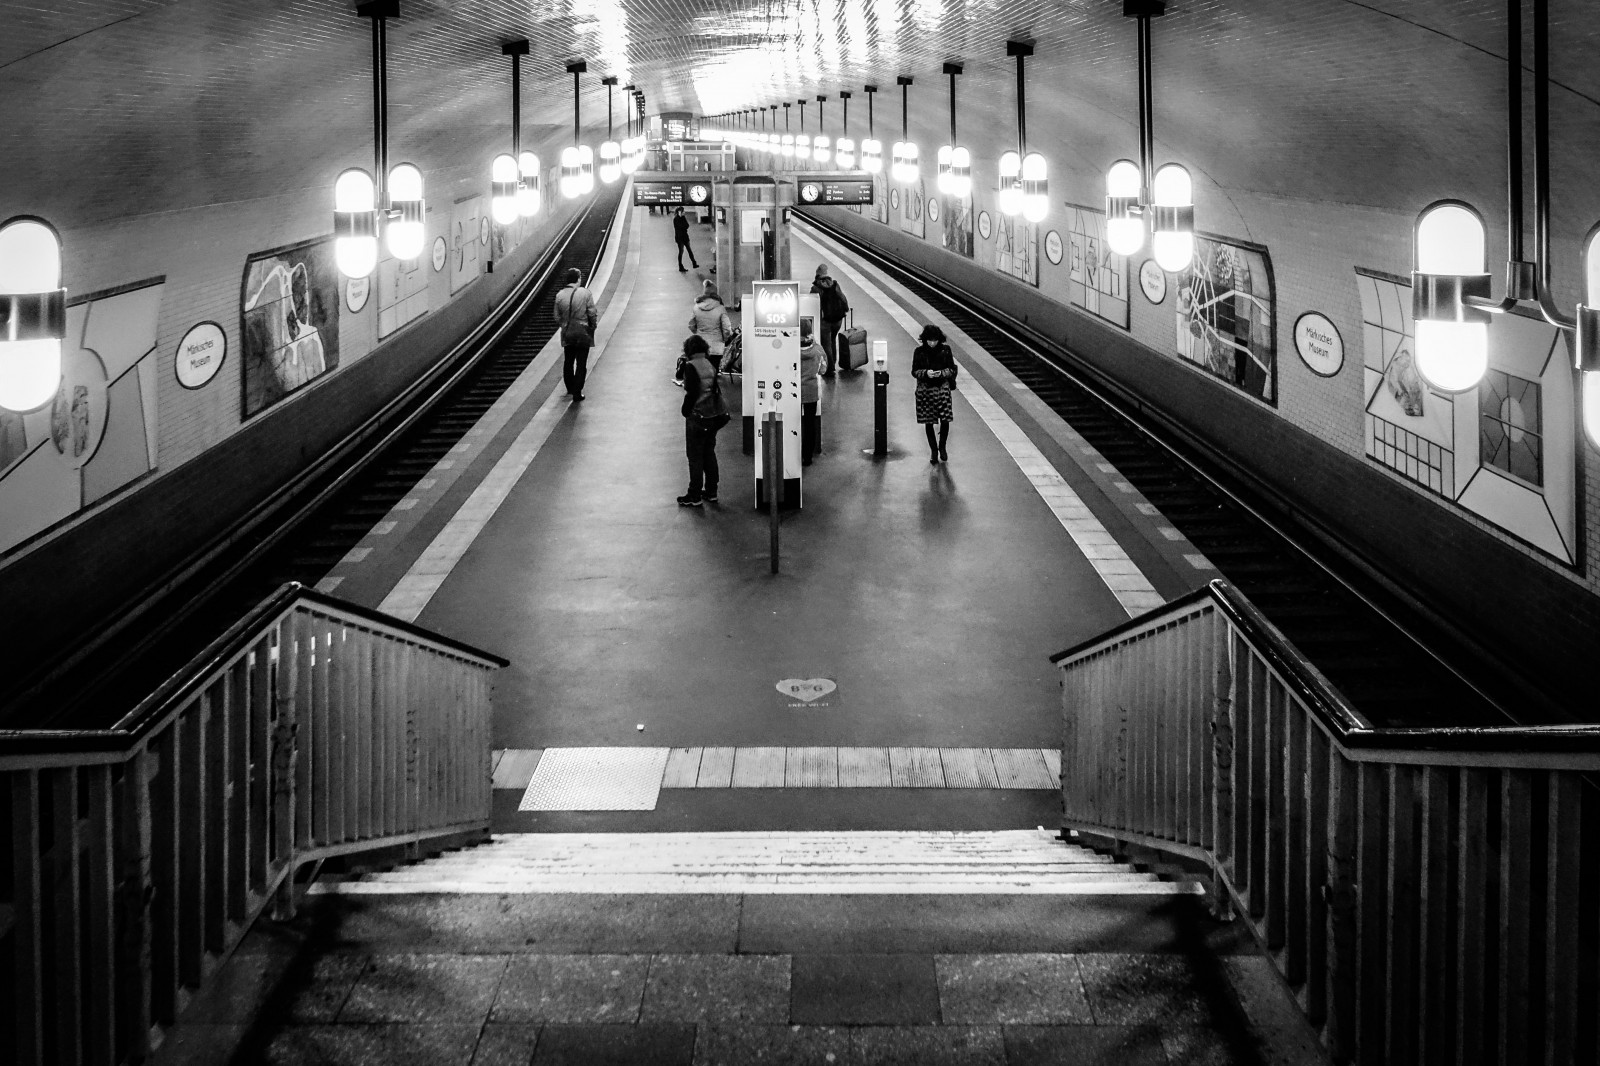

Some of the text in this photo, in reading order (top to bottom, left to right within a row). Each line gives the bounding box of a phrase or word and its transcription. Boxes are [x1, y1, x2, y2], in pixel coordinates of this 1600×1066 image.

[766, 313, 786, 324] SOS
[1306, 327, 1333, 346] Märkisches
[187, 340, 214, 355] Märkisches
[1308, 342, 1330, 358] Museum
[190, 355, 211, 370] Museum
